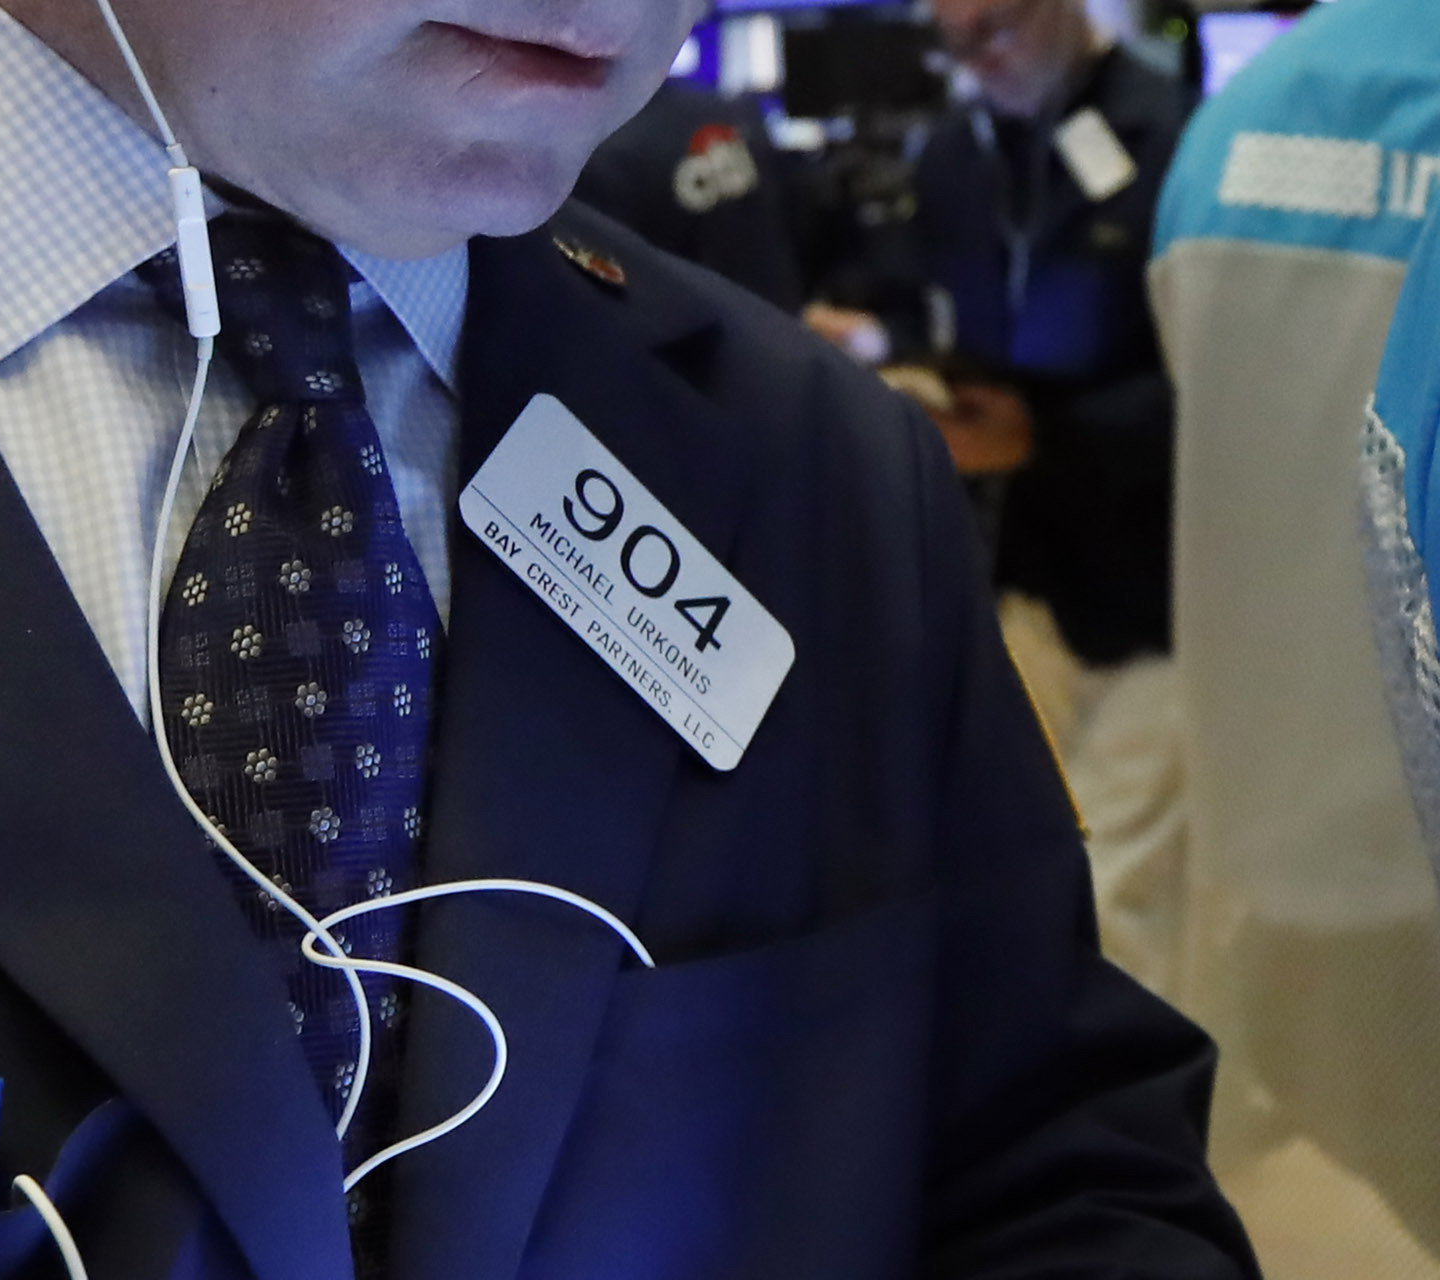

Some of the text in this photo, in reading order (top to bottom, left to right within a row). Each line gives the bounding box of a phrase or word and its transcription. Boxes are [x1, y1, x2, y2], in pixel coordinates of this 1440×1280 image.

[482, 520, 523, 559] BAY
[526, 562, 583, 618] CREST
[683, 713, 715, 750] LLC
[530, 512, 712, 695] MICHAEL URKONIS
[563, 468, 731, 654] 904
